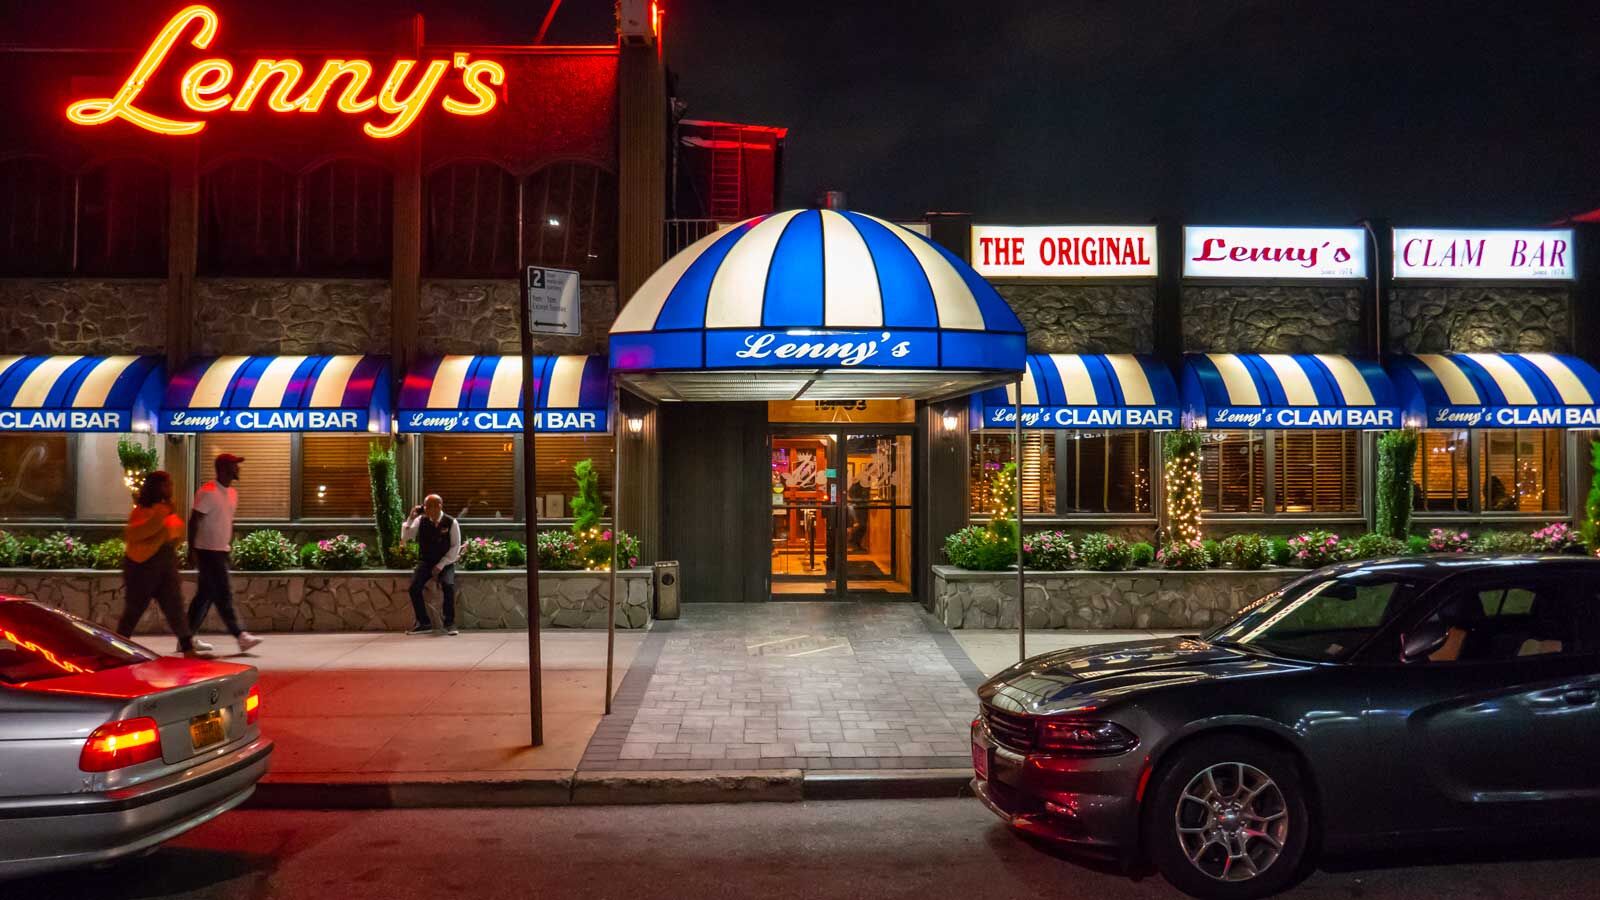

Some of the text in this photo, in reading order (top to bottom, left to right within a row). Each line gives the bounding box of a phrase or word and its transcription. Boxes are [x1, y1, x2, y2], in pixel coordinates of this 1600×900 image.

[66, 5, 505, 138] Lenny's
[980, 236, 1151, 266] THE ORIGINAL
[1192, 238, 1351, 268] Lenny's
[1403, 238, 1567, 267] CLAM BAR
[533, 270, 542, 287] 2
[736, 332, 911, 366] Lenny's
[0, 411, 120, 429] CLAM BAR
[170, 410, 358, 430] Lenny's CLAM BAR
[409, 411, 470, 431] Lenny's
[547, 412, 596, 428] BAR
[1055, 408, 1122, 425] CLAM
[1126, 409, 1173, 425] BAR
[1214, 407, 1393, 427] Lenny's CLAM BAR
[1435, 407, 1600, 427] Lenny's CLAM BA
